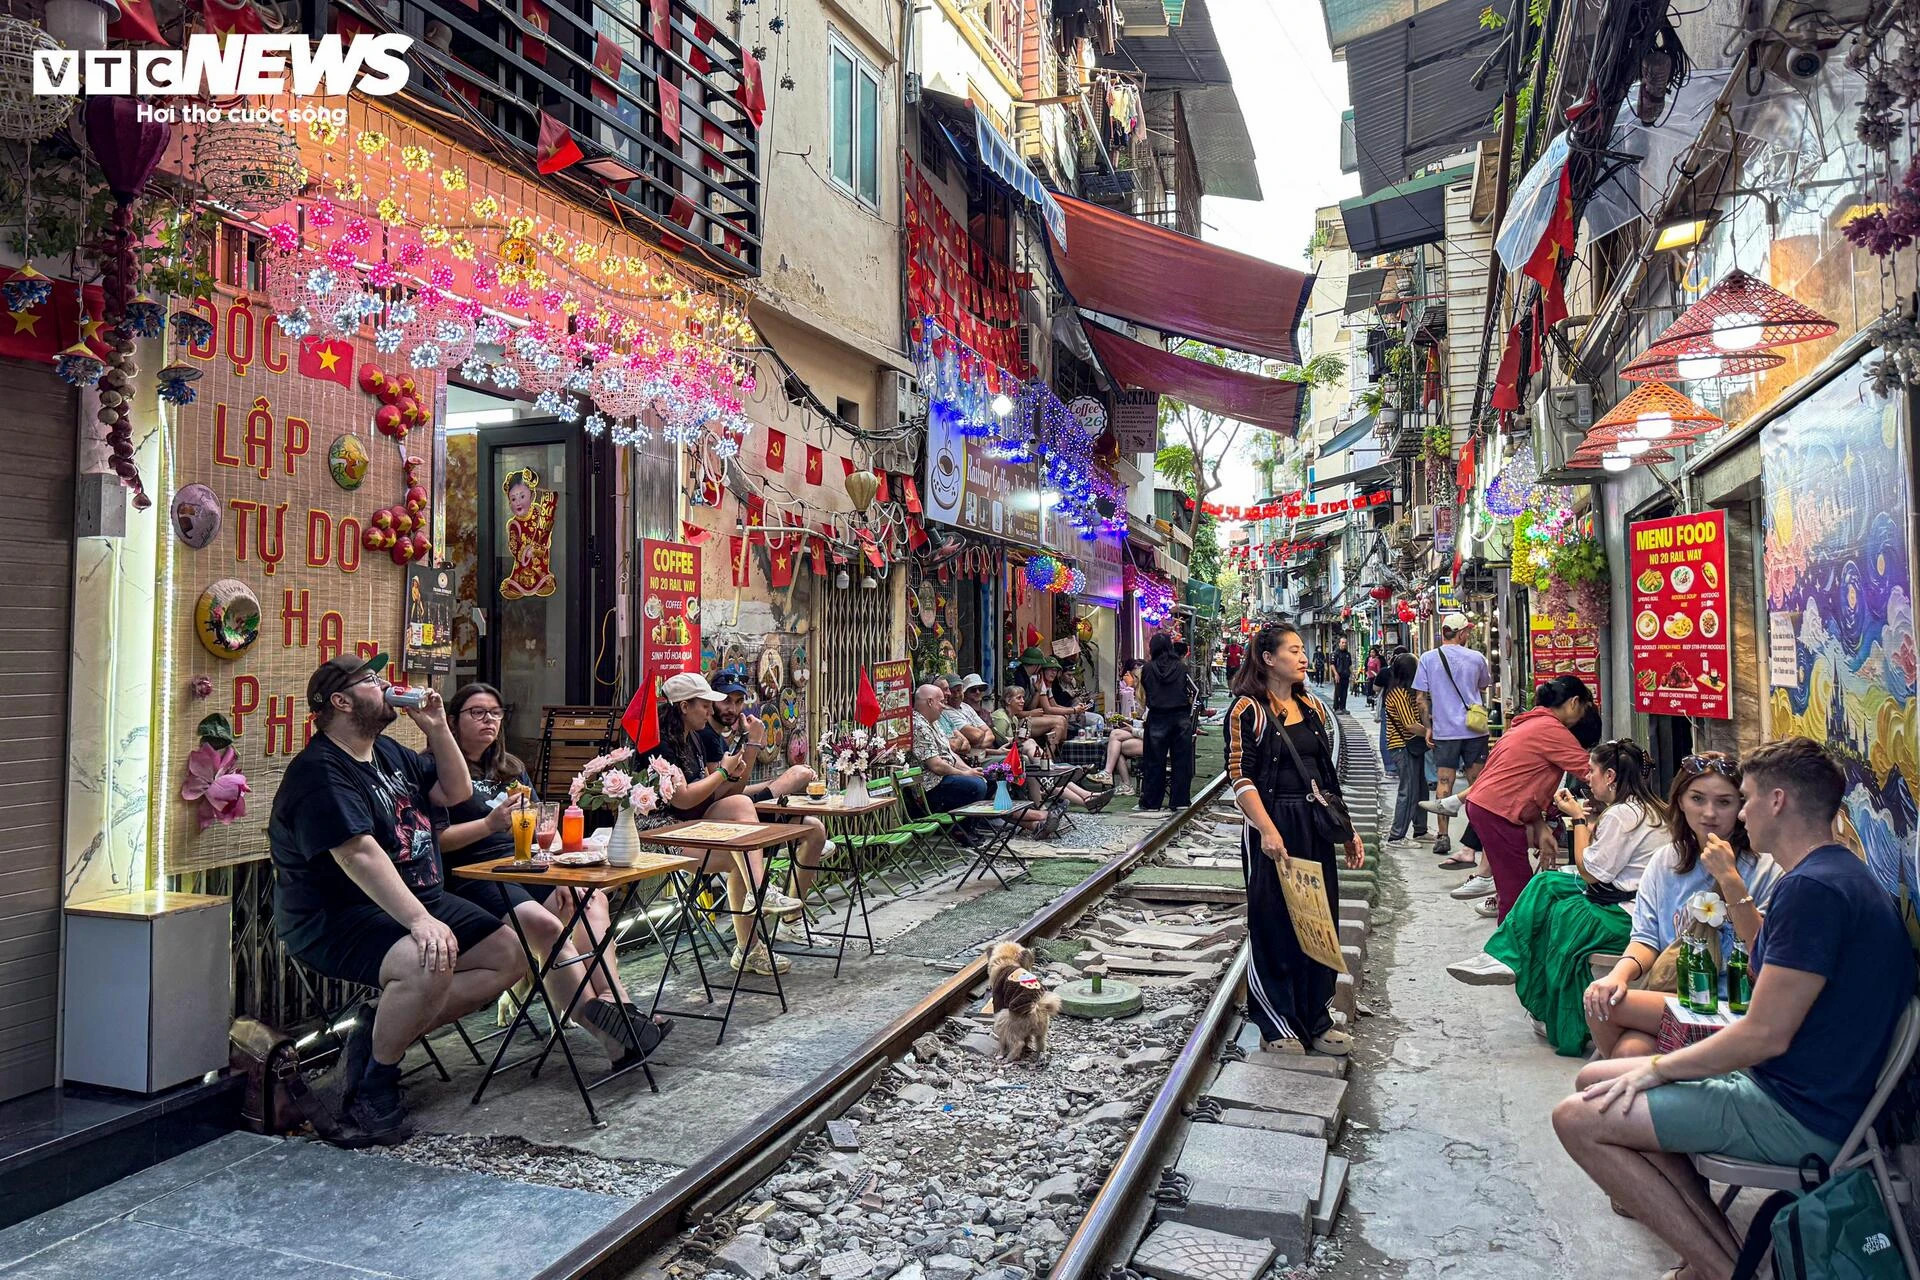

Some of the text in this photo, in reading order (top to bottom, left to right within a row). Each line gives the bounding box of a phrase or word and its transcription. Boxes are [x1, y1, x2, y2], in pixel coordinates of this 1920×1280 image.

[1117, 390, 1156, 405] CKTAIL
[1070, 403, 1099, 417] Coffee
[1084, 416, 1103, 427] 26
[214, 396, 311, 479] LẬP
[230, 499, 361, 575] TỰ DO
[1636, 521, 1716, 551] MENU FOOD
[653, 547, 694, 575] COFFEE
[1649, 548, 1702, 565] NO 20 RAIL WAY
[650, 576, 696, 593] NO 20 RAIL WAY
[665, 600, 682, 609] COFFEE
